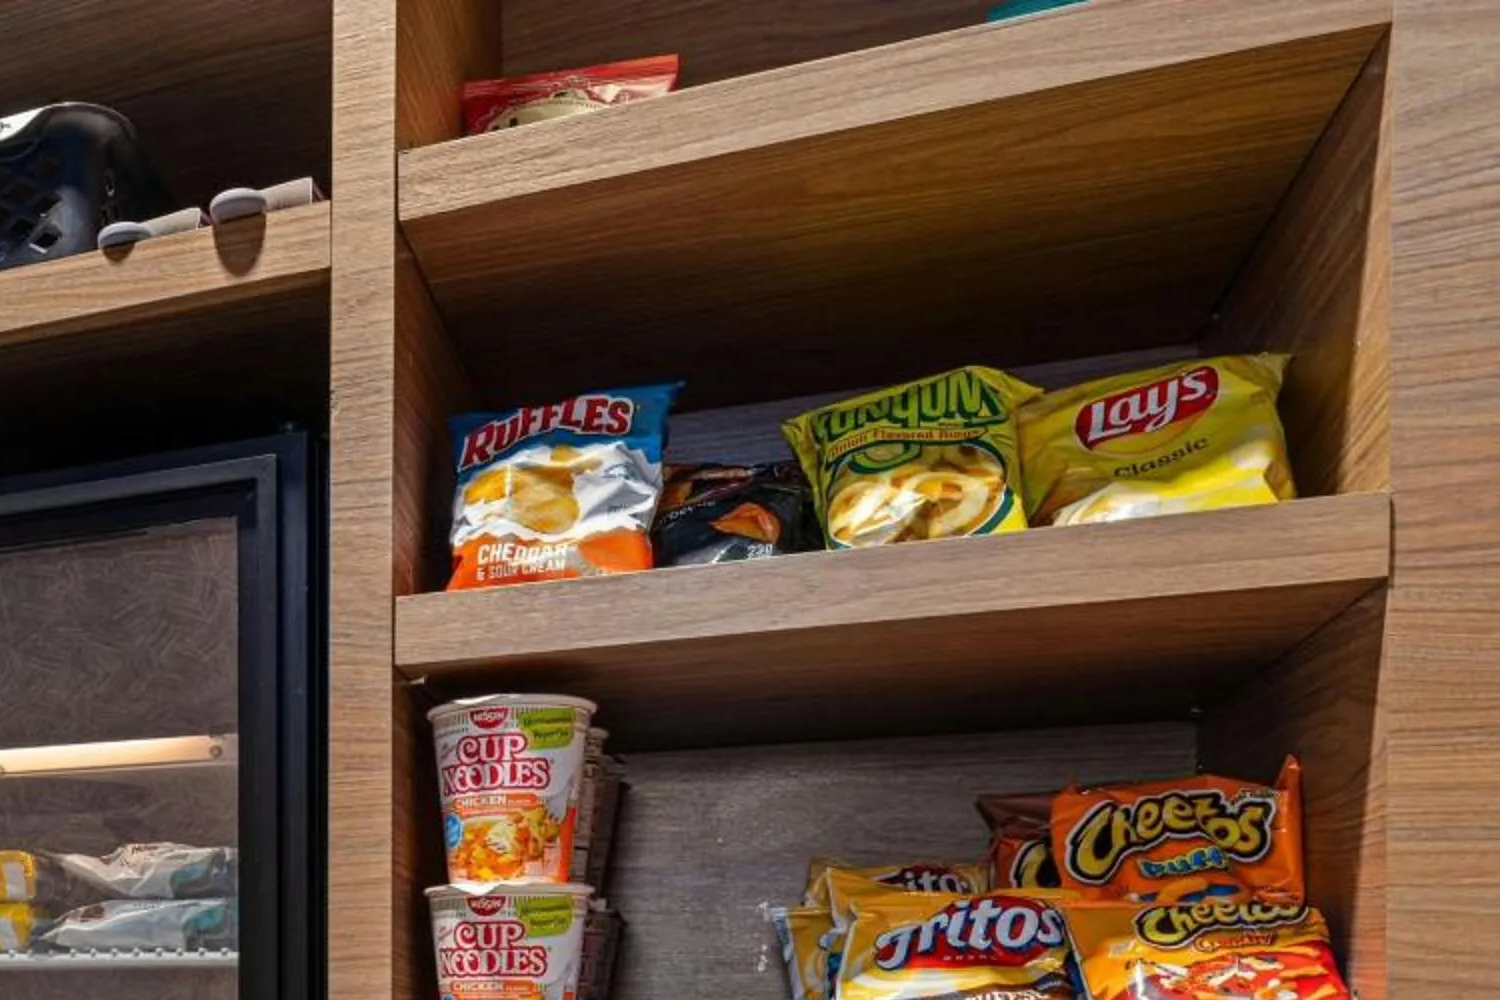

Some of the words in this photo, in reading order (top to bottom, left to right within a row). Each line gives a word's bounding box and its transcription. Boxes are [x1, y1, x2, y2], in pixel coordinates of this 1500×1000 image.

[1087, 369, 1212, 443] Lay's
[460, 394, 633, 469] RUFFLES
[1113, 438, 1210, 478] Classic
[458, 734, 527, 764] CUP
[442, 760, 549, 795] NOODLES
[455, 922, 523, 949] CUP
[875, 897, 1064, 970] Fritos
[440, 947, 546, 977] NOODLES
